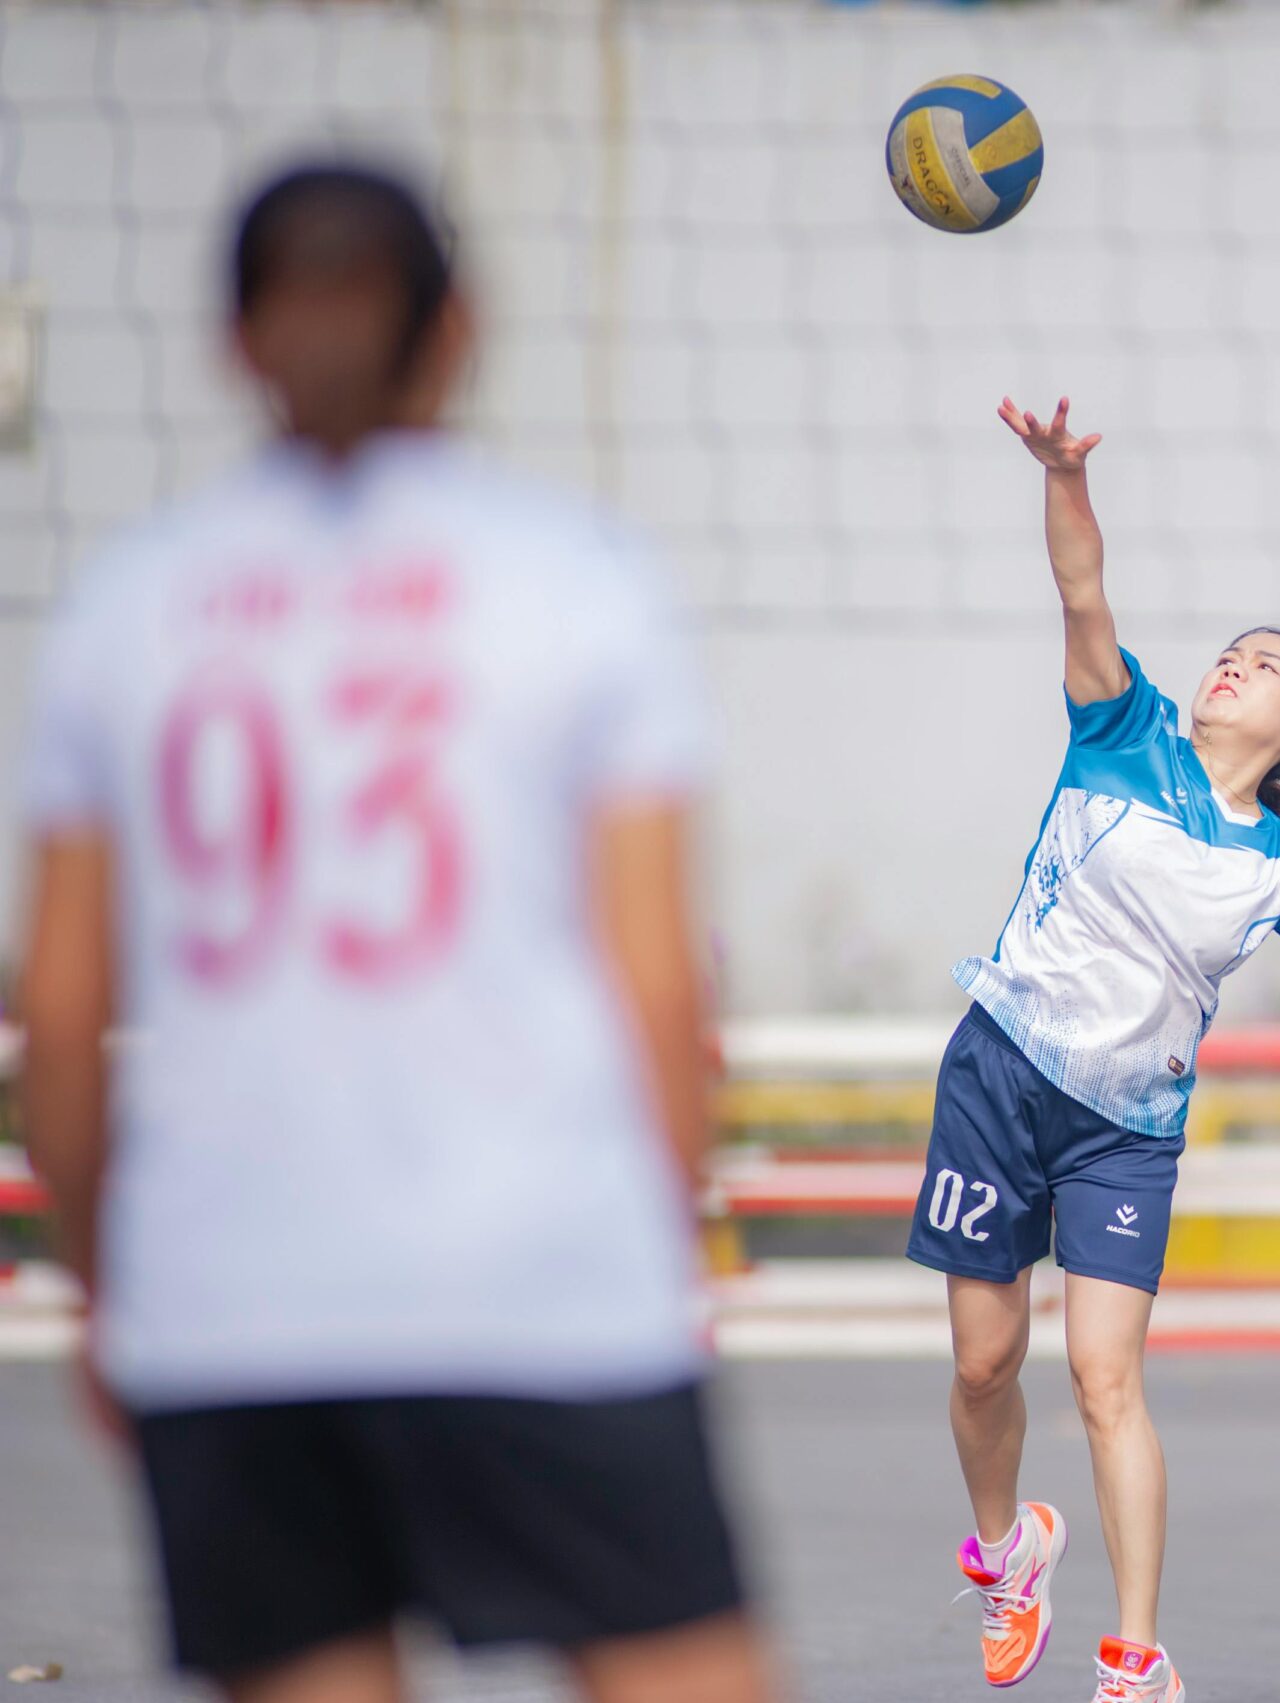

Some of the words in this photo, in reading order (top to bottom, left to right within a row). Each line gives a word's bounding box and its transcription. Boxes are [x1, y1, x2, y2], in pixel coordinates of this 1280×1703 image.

[913, 136, 954, 215] DRAGON
[160, 662, 474, 990] 93
[928, 1168, 998, 1242] 02
